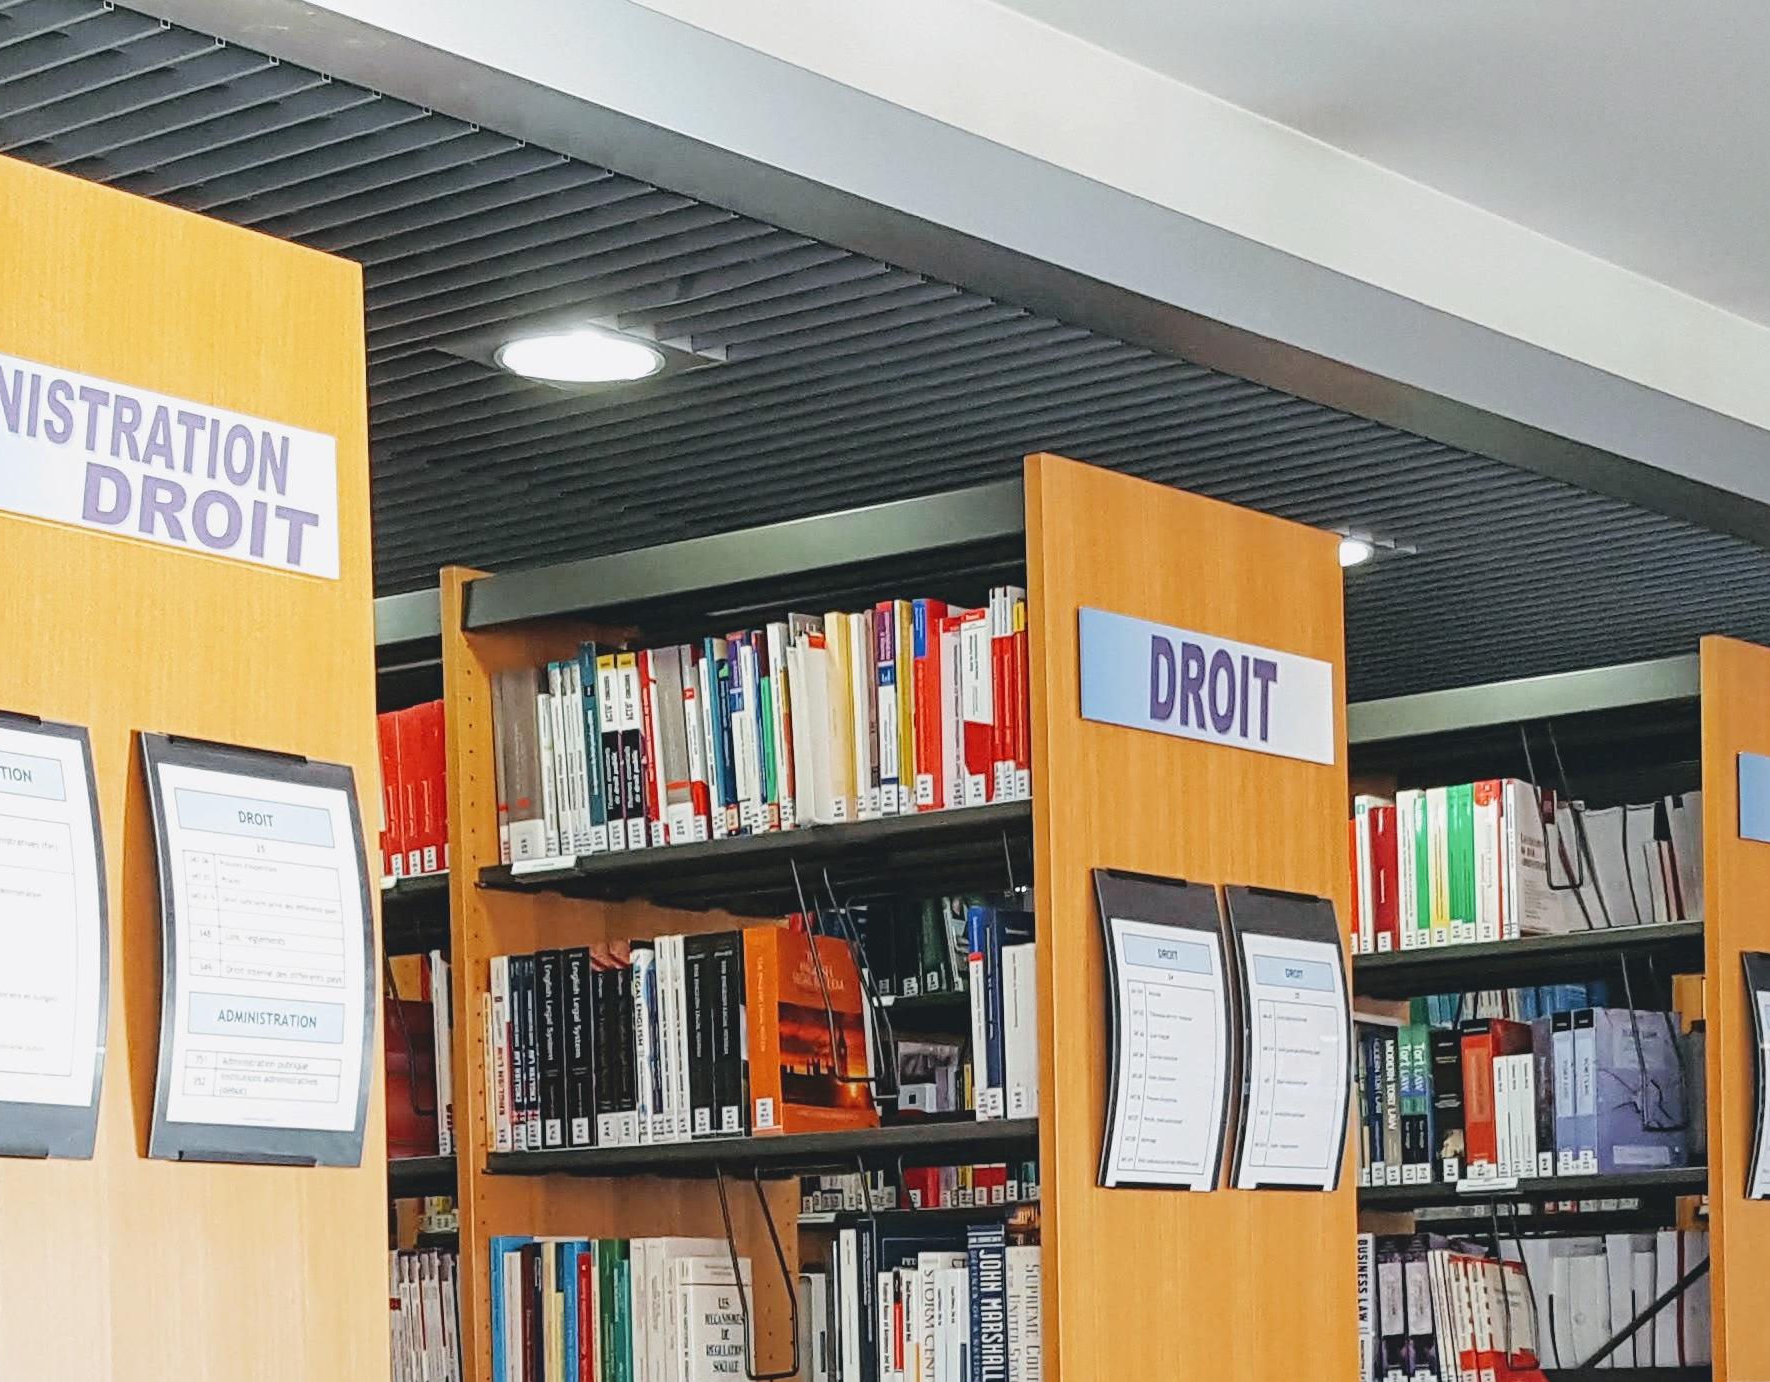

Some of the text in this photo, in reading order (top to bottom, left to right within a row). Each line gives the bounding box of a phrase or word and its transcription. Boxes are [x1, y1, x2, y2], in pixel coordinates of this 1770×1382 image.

[81, 460, 319, 566] DROIT
[1149, 634, 1278, 742] DROIT
[238, 810, 274, 827] DROIT
[217, 1009, 317, 1028] ADMINISTRATION
[544, 964, 554, 1061] English Legal System
[571, 961, 582, 1059] English Legal System
[634, 970, 644, 1047] LEGAL ENGLISH
[1384, 1039, 1397, 1131] MODERN TORT LAW
[1413, 1042, 1424, 1092] Tort LAW
[924, 1270, 934, 1329] STORM
[980, 1250, 1004, 1382] JOHN MARSHALL
[1009, 1295, 1020, 1344] UNITED
[1025, 1264, 1039, 1338] SUPREME
[1358, 1238, 1368, 1323] BUSINESS LAW
